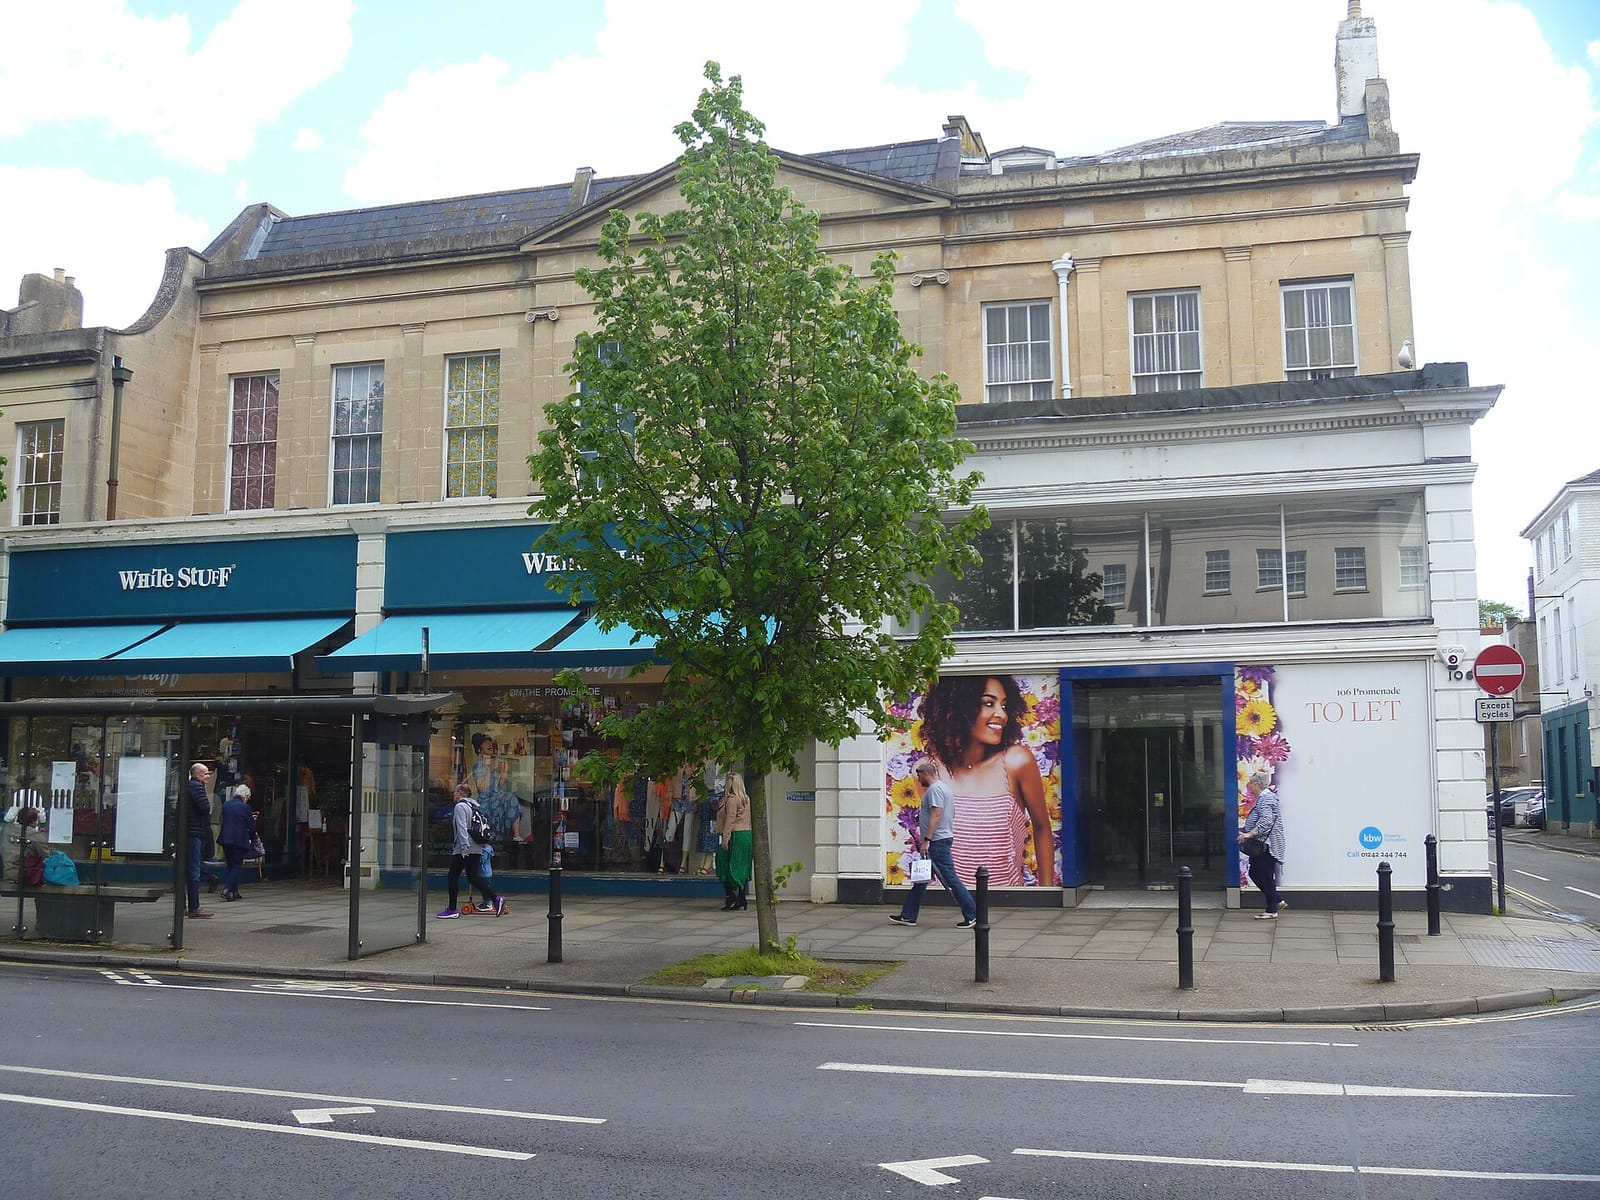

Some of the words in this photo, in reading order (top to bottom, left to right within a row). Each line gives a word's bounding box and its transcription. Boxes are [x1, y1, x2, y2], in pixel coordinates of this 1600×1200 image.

[112, 688, 155, 696] PROMENADE
[509, 688, 522, 697] ON
[523, 688, 541, 697] THE
[1337, 688, 1352, 696] 106
[1353, 686, 1401, 696] Promenade
[1480, 702, 1511, 710] Except
[1305, 701, 1344, 723] TO
[1351, 700, 1401, 722] LET
[1481, 710, 1509, 719] cycles
[1363, 833, 1382, 842] kbw
